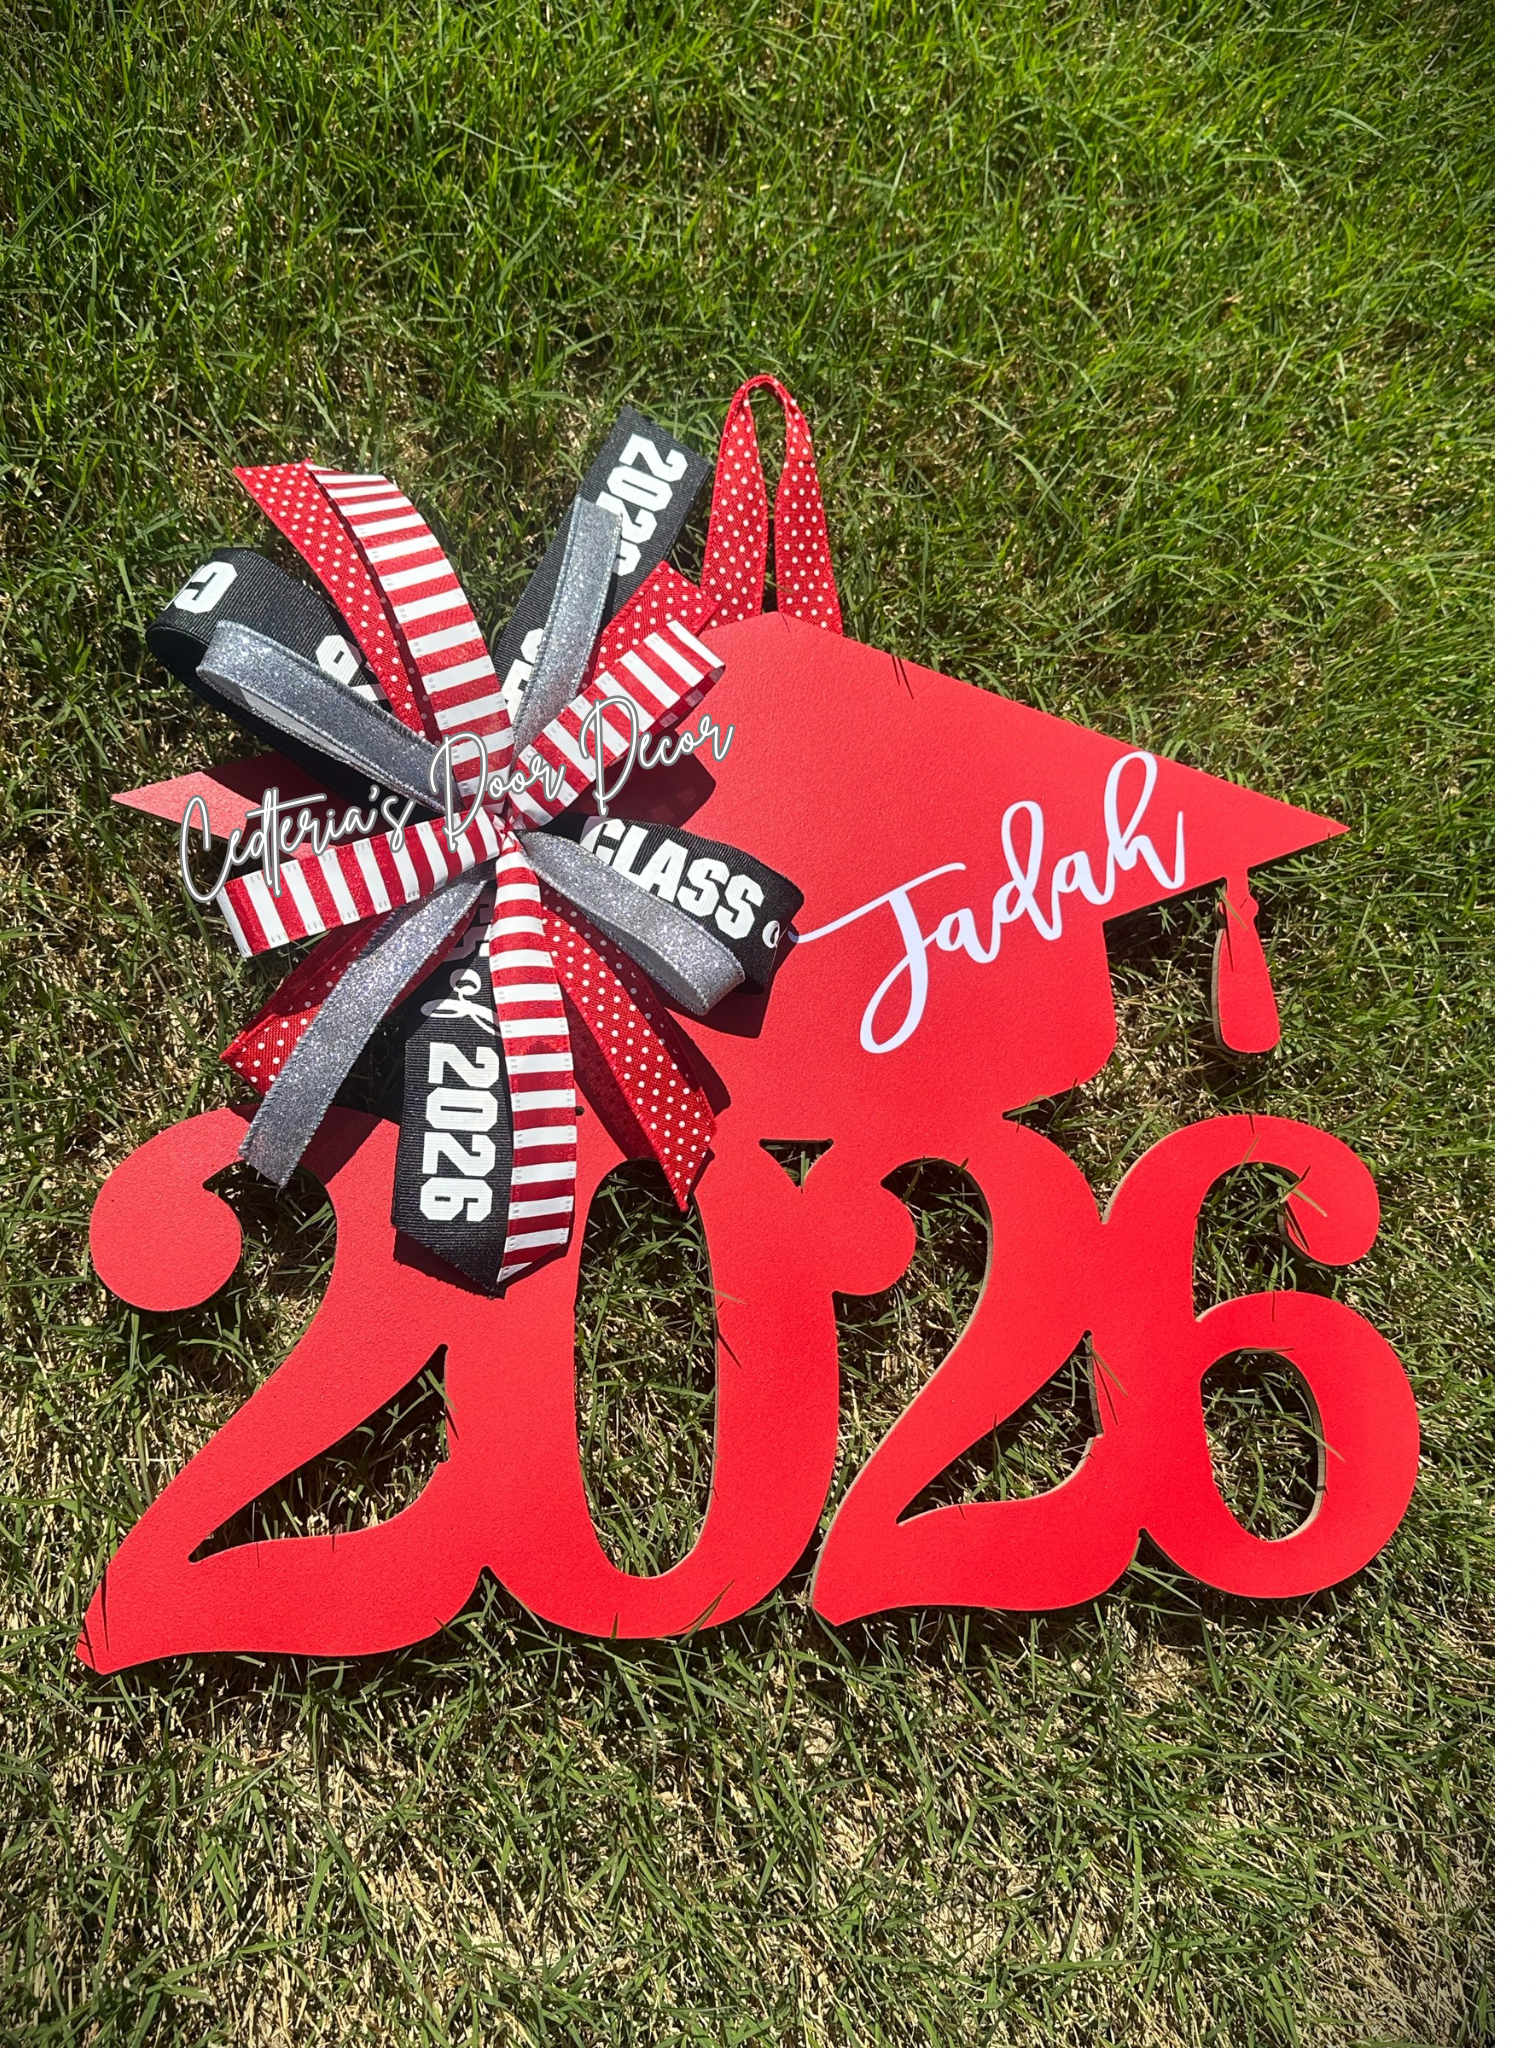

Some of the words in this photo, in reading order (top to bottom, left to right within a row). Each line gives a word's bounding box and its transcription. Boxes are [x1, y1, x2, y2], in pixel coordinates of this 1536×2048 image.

[580, 816, 764, 939] CLASS
[788, 751, 1186, 1055] Jadah
[419, 1041, 500, 1222] 2026
[76, 1107, 1421, 1675] 2026
